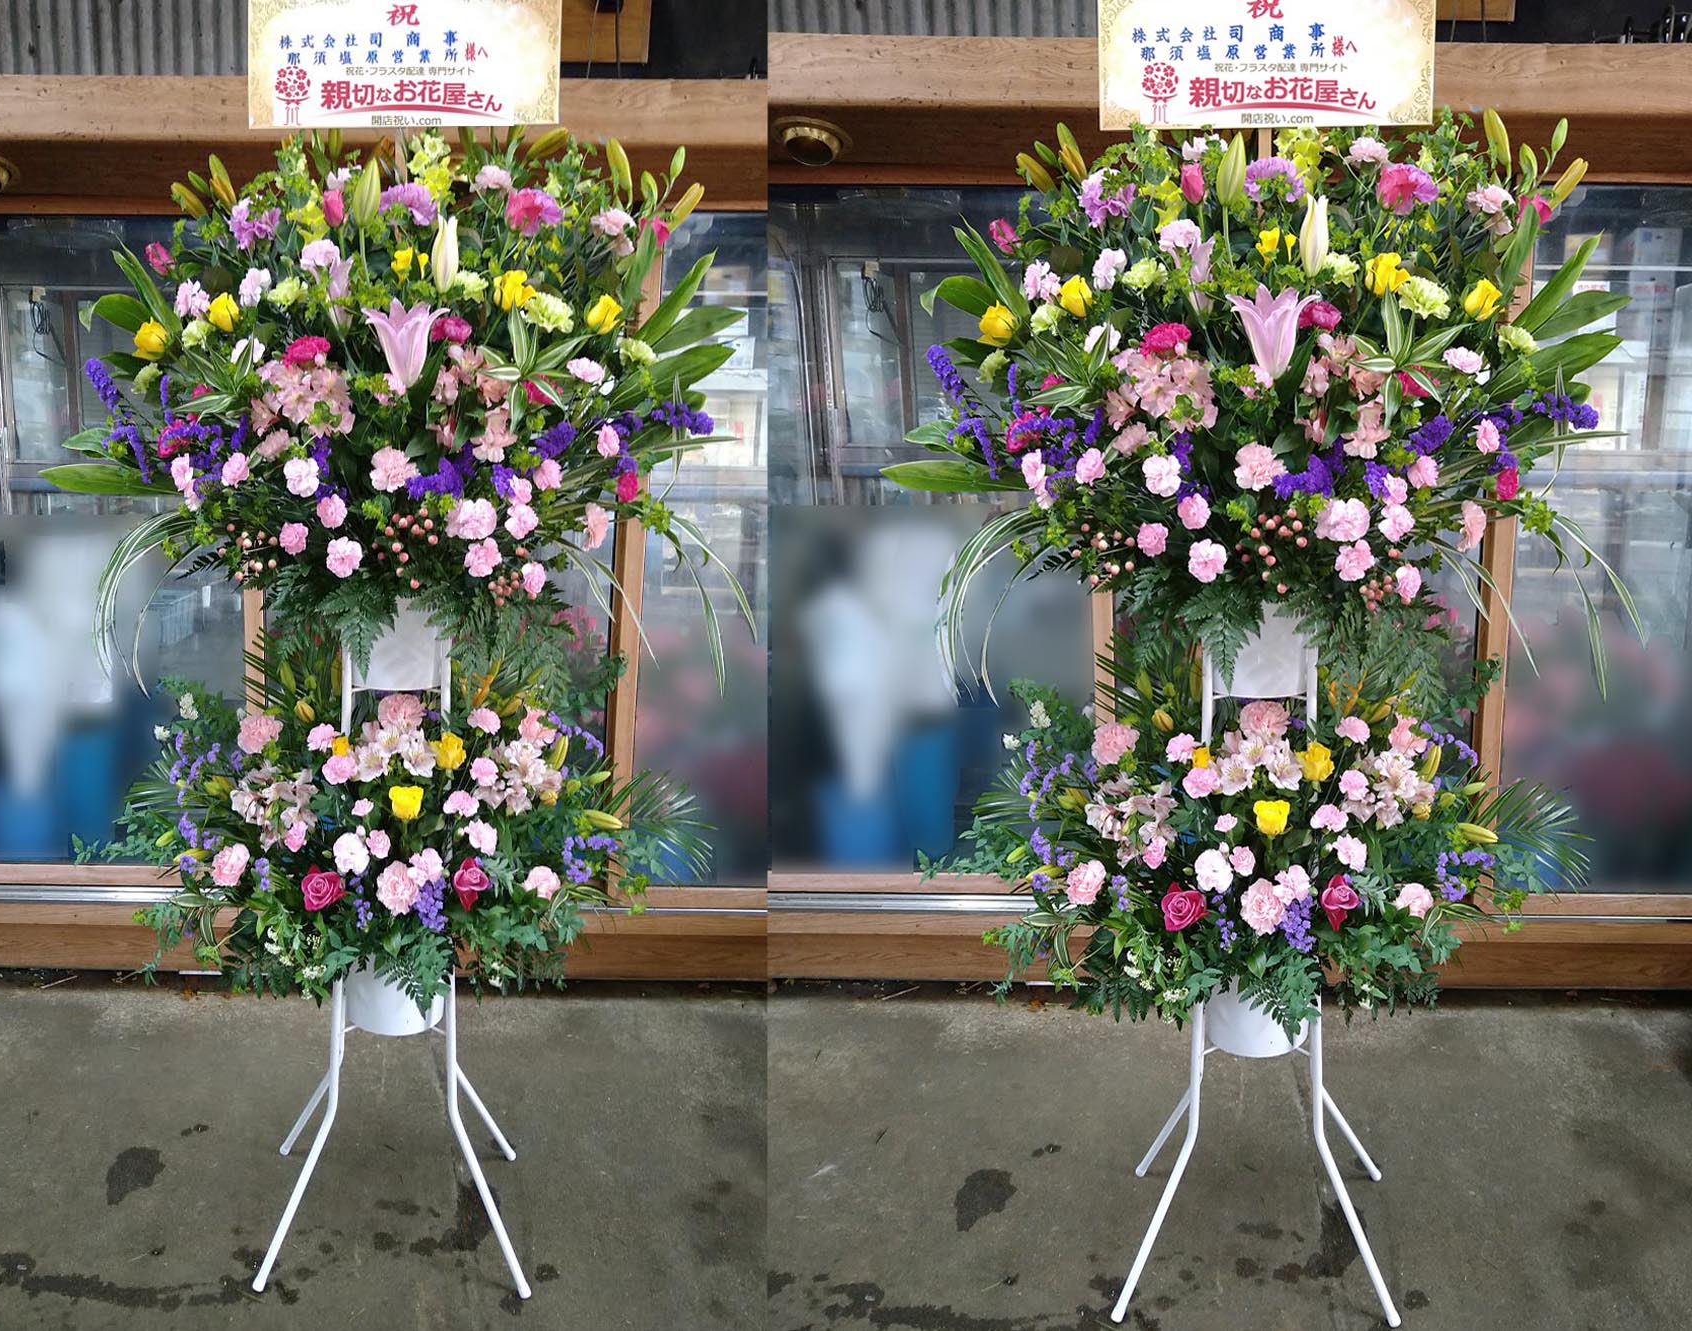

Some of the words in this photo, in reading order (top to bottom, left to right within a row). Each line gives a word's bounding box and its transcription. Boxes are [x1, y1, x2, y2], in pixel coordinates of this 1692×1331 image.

[386, 4, 419, 26] 祝
[429, 67, 474, 75] 専門サイト
[1300, 63, 1347, 72] 専門サイト
[321, 80, 502, 113] 親切なお花屋さん
[1189, 77, 1376, 111] 親切なお花屋さん
[372, 116, 441, 125] 開店祝い.com
[1241, 113, 1313, 124] 開店祝い.com
